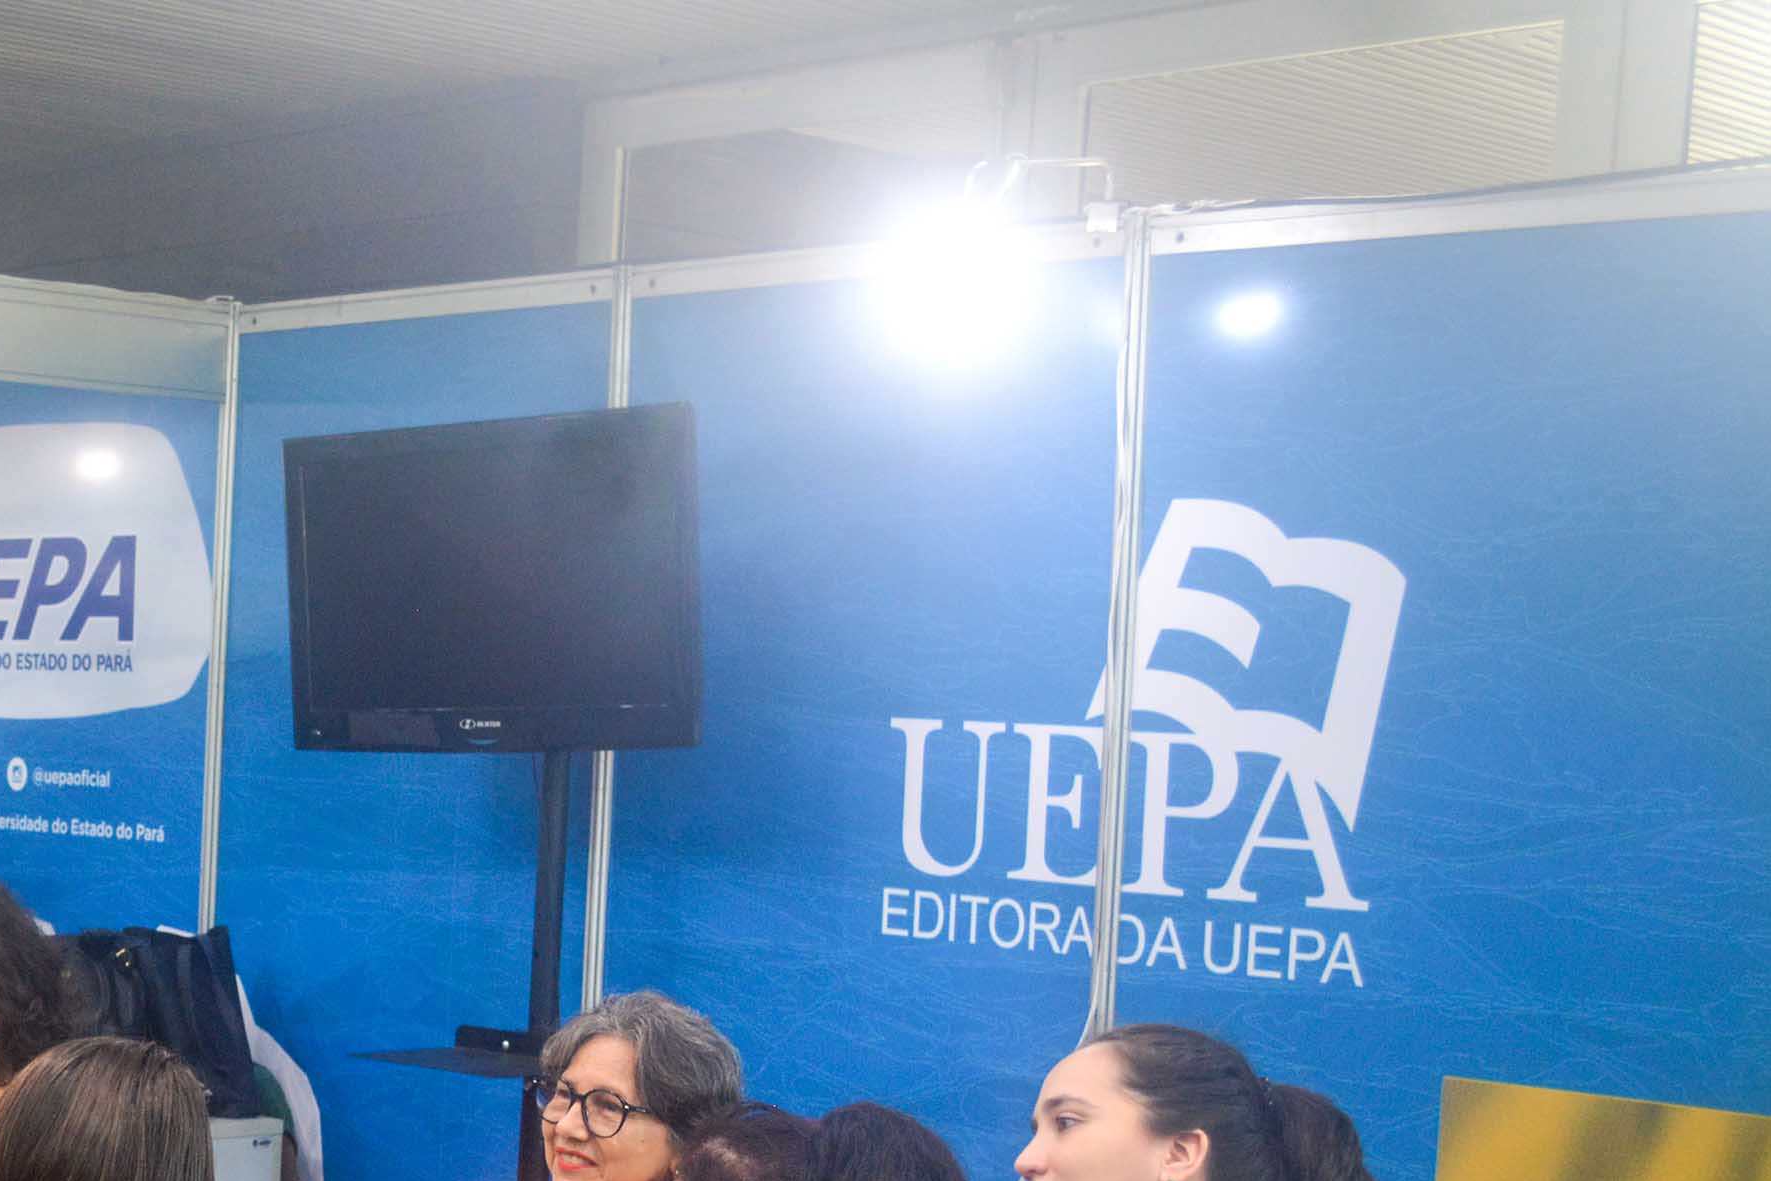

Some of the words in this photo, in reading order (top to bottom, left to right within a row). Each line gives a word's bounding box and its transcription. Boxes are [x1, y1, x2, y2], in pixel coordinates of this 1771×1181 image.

[16, 653, 68, 672] ESTADO
[72, 654, 92, 672] DO
[97, 648, 134, 673] PARÁ
[33, 766, 111, 789] @uepaoficial
[890, 716, 1370, 914] UEPA
[52, 816, 68, 835] do
[70, 819, 113, 839] Estado
[116, 821, 132, 841] do
[136, 824, 165, 843] Pará
[880, 886, 1094, 958] EDITORA
[1116, 913, 1188, 971] DA
[1203, 919, 1364, 989] UEPA
